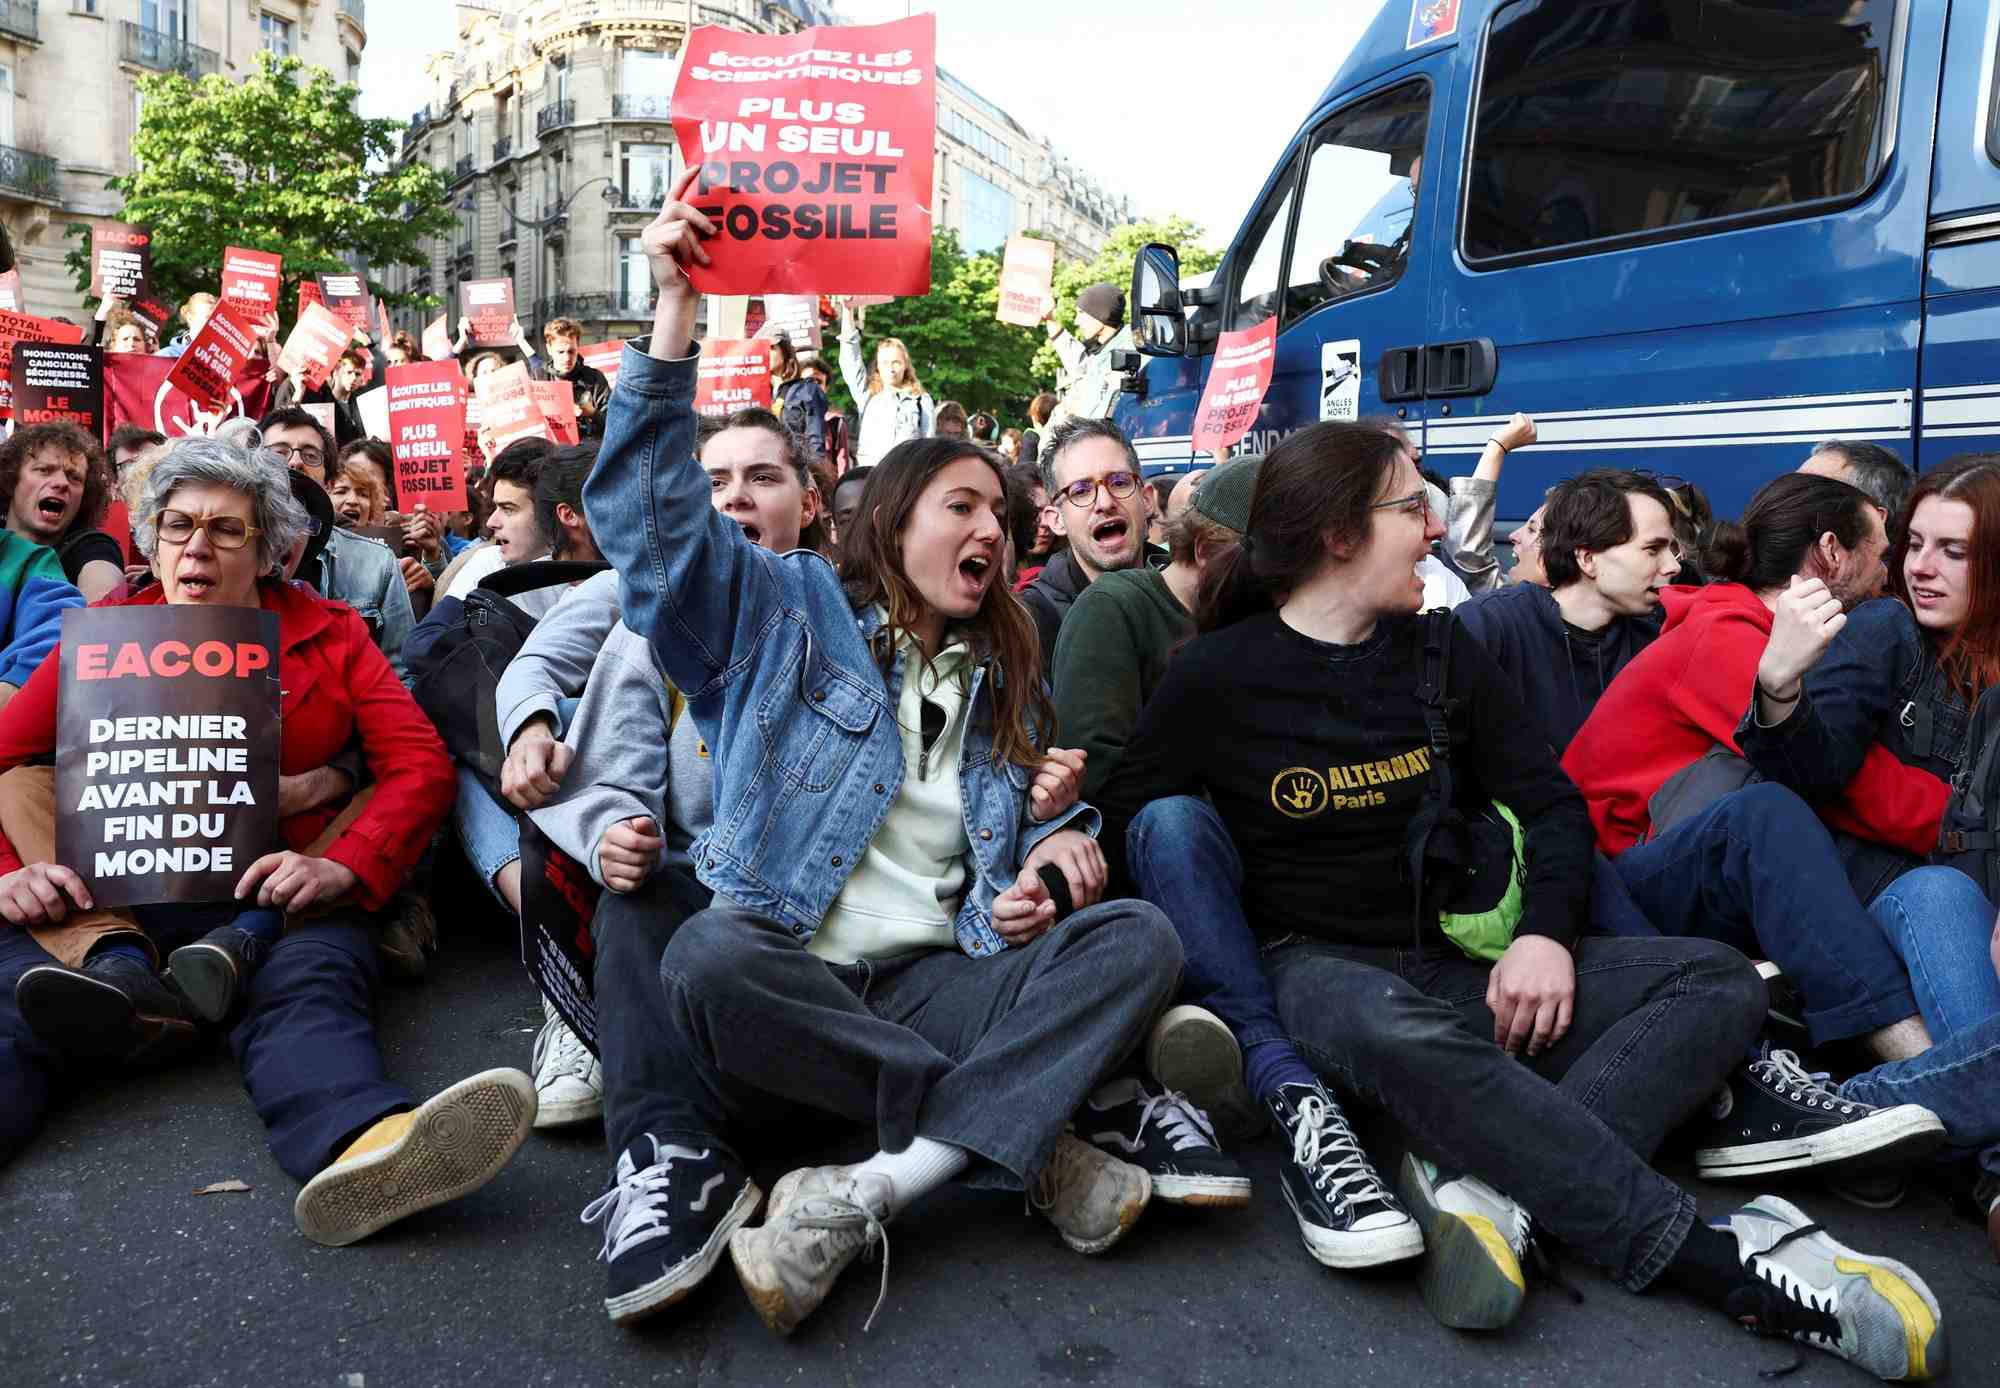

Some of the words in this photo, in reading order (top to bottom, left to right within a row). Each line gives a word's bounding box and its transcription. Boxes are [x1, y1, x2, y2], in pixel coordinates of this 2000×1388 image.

[708, 49, 850, 68] ÉCOUTEZ
[857, 49, 912, 68] LES
[691, 64, 922, 86] SCIENTIFIQUES
[737, 97, 865, 125] PLUS
[699, 121, 767, 153] UN
[777, 125, 904, 158] SEUL
[697, 160, 897, 196] PROJET
[696, 204, 898, 241] FOSSILE
[131, 270, 143, 279] LA
[0, 314, 43, 332] TOTAL
[23, 349, 92, 363] INONDATIONS,
[193, 346, 211, 364] UN
[209, 360, 233, 382] SEUL
[207, 342, 234, 367] PLUS
[745, 354, 764, 365] LES
[28, 360, 86, 371] CANICULES,
[391, 383, 430, 398] ÉCOUTEZ
[431, 381, 452, 394] LES
[712, 388, 752, 402] PLUS
[47, 396, 69, 409] LE
[1208, 401, 1257, 420] PROJET
[1326, 397, 1353, 407] ANGLES
[1327, 407, 1352, 416] MORTS
[402, 424, 437, 441] PLUS
[395, 443, 410, 460] UN
[412, 441, 452, 458] SEUL
[400, 459, 450, 476] PROJET
[402, 477, 454, 494] FOSSILE
[76, 640, 270, 681] EACOP
[89, 715, 247, 744] DERNIER
[86, 748, 248, 777] PIPELINE
[76, 780, 202, 812] AVANT
[207, 780, 257, 806] LA
[1332, 789, 1387, 811] Paris
[103, 814, 164, 843] FIN
[171, 813, 225, 839] DU
[95, 847, 233, 879] MONDE
